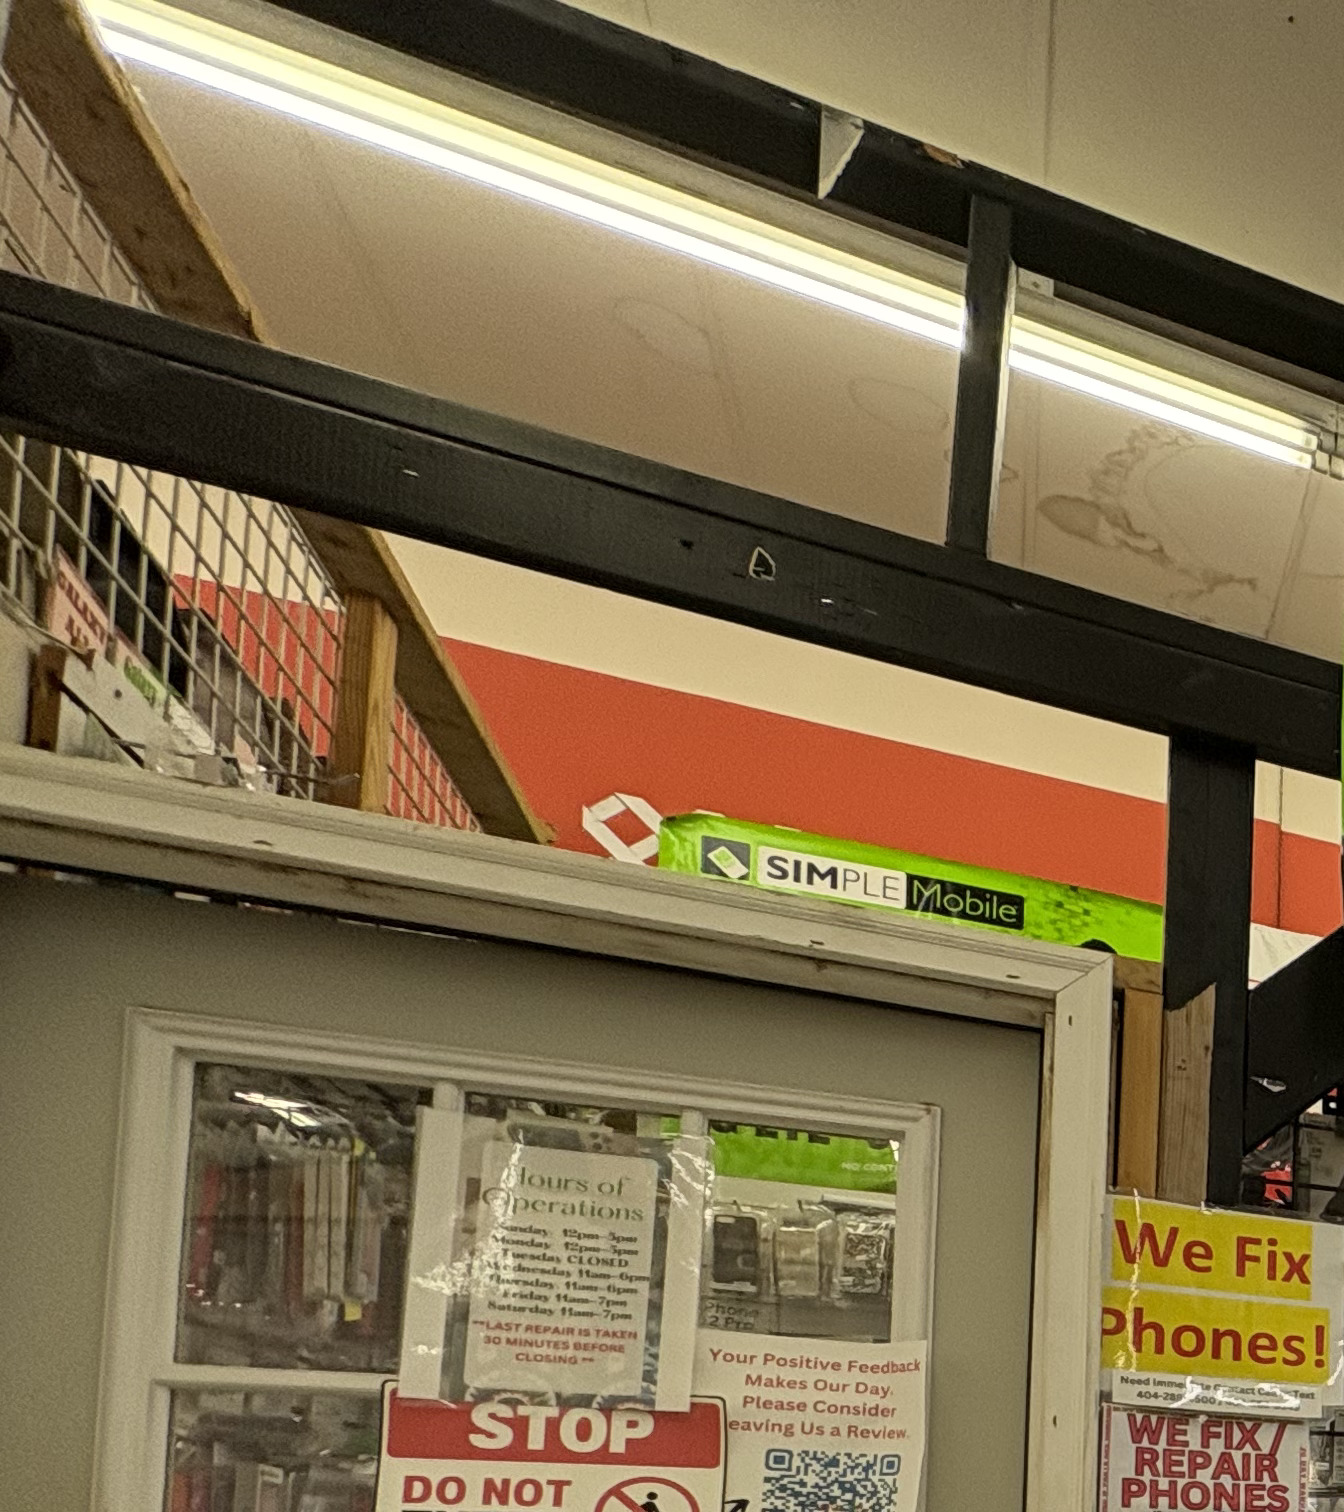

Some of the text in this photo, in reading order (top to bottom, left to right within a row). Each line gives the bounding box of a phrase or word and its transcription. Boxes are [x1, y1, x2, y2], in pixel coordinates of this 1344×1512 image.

[764, 852, 1019, 926] SIMPLE Mobile
[566, 1254, 630, 1268] CLOSED
[1114, 1217, 1312, 1286] We Fix
[525, 1322, 638, 1340] REPAIR IS TAKEN
[1101, 1304, 1327, 1370] Phones!
[505, 1336, 626, 1354] MINUTES BEFORE
[515, 1352, 579, 1365] CLOSING
[708, 1348, 922, 1375] Your Positive Feedback
[744, 1374, 850, 1393] Makes Our
[741, 1395, 898, 1419] Please Consider
[468, 1402, 656, 1455] STOP
[800, 1420, 843, 1438] Us a
[1126, 1412, 1263, 1452] WE FIX
[1134, 1445, 1280, 1484] REPAIR
[401, 1474, 574, 1509] DO NOT
